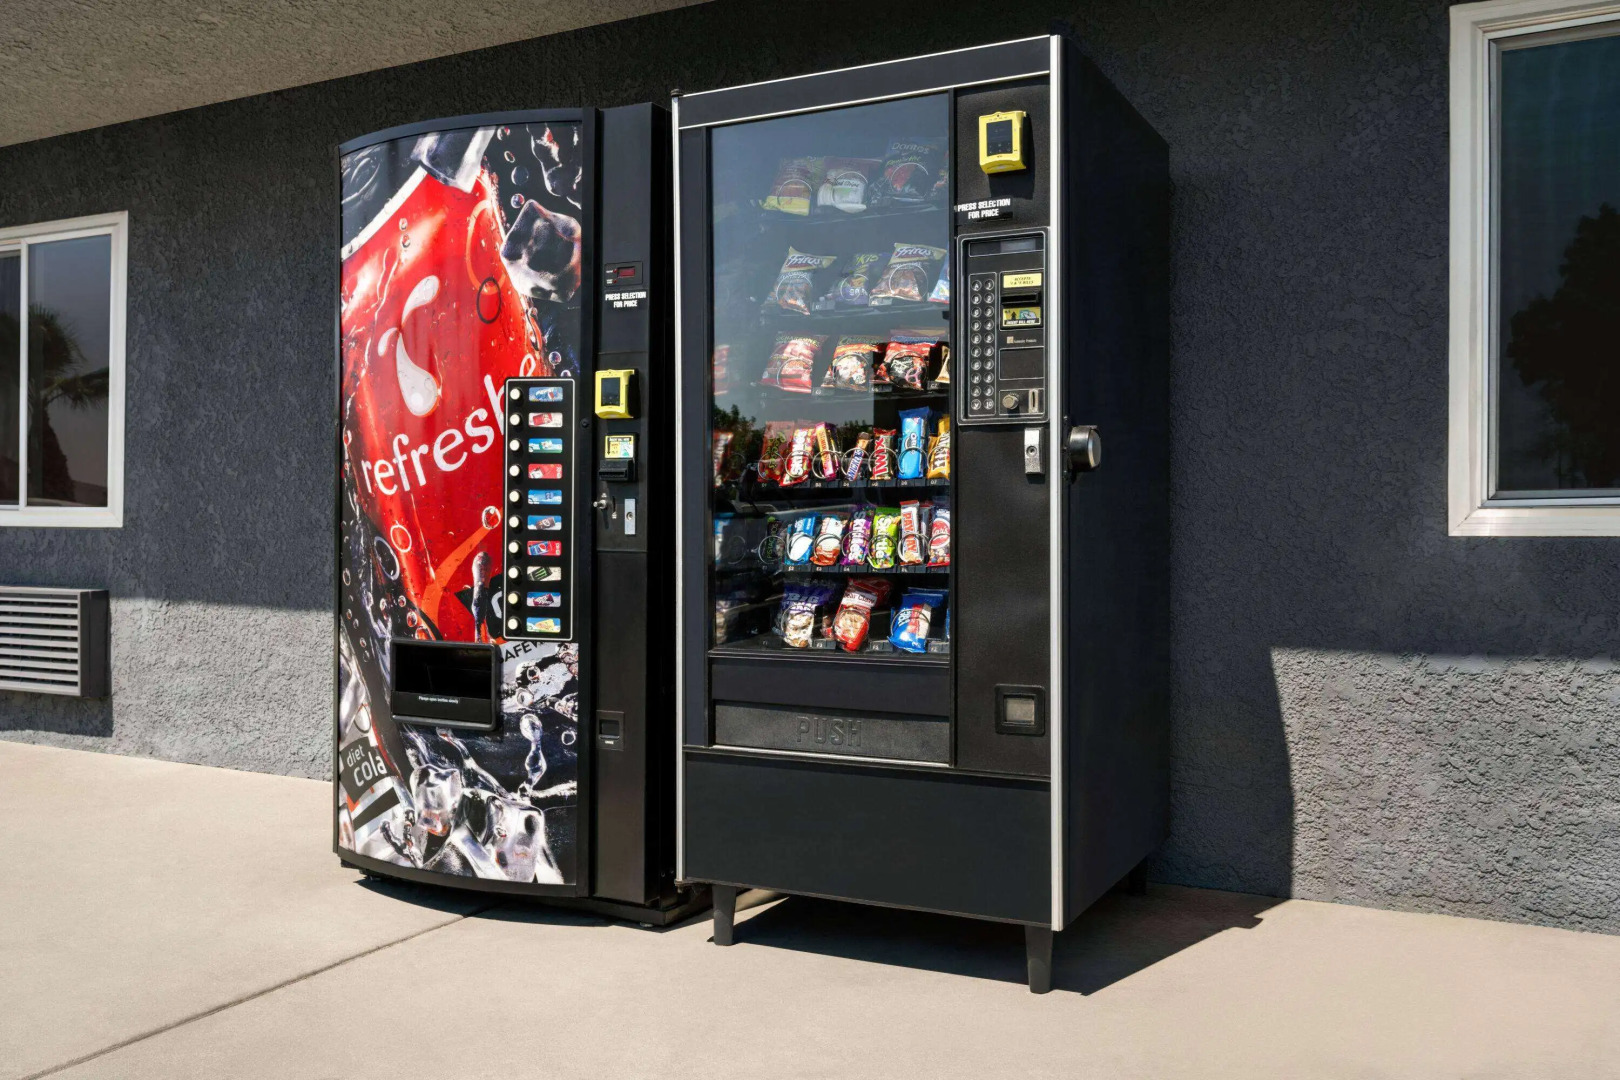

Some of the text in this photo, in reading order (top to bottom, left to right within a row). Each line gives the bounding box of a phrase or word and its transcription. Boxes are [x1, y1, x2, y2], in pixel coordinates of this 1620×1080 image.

[891, 143, 930, 155] Doritos
[957, 198, 1011, 212] PRESS SELECTION
[967, 208, 999, 220] FOR PRICE
[896, 246, 932, 258] Fritos
[785, 254, 821, 268] Fritos
[605, 291, 647, 301] PRESS SELECTION
[623, 300, 638, 308] PRICE
[846, 448, 865, 481] SNICKERS
[848, 510, 867, 561] Skittles
[874, 516, 892, 564] Skittles
[787, 592, 820, 604] BIG
[796, 715, 862, 747] PUSH
[346, 744, 366, 768] diet
[353, 751, 388, 787] cola
